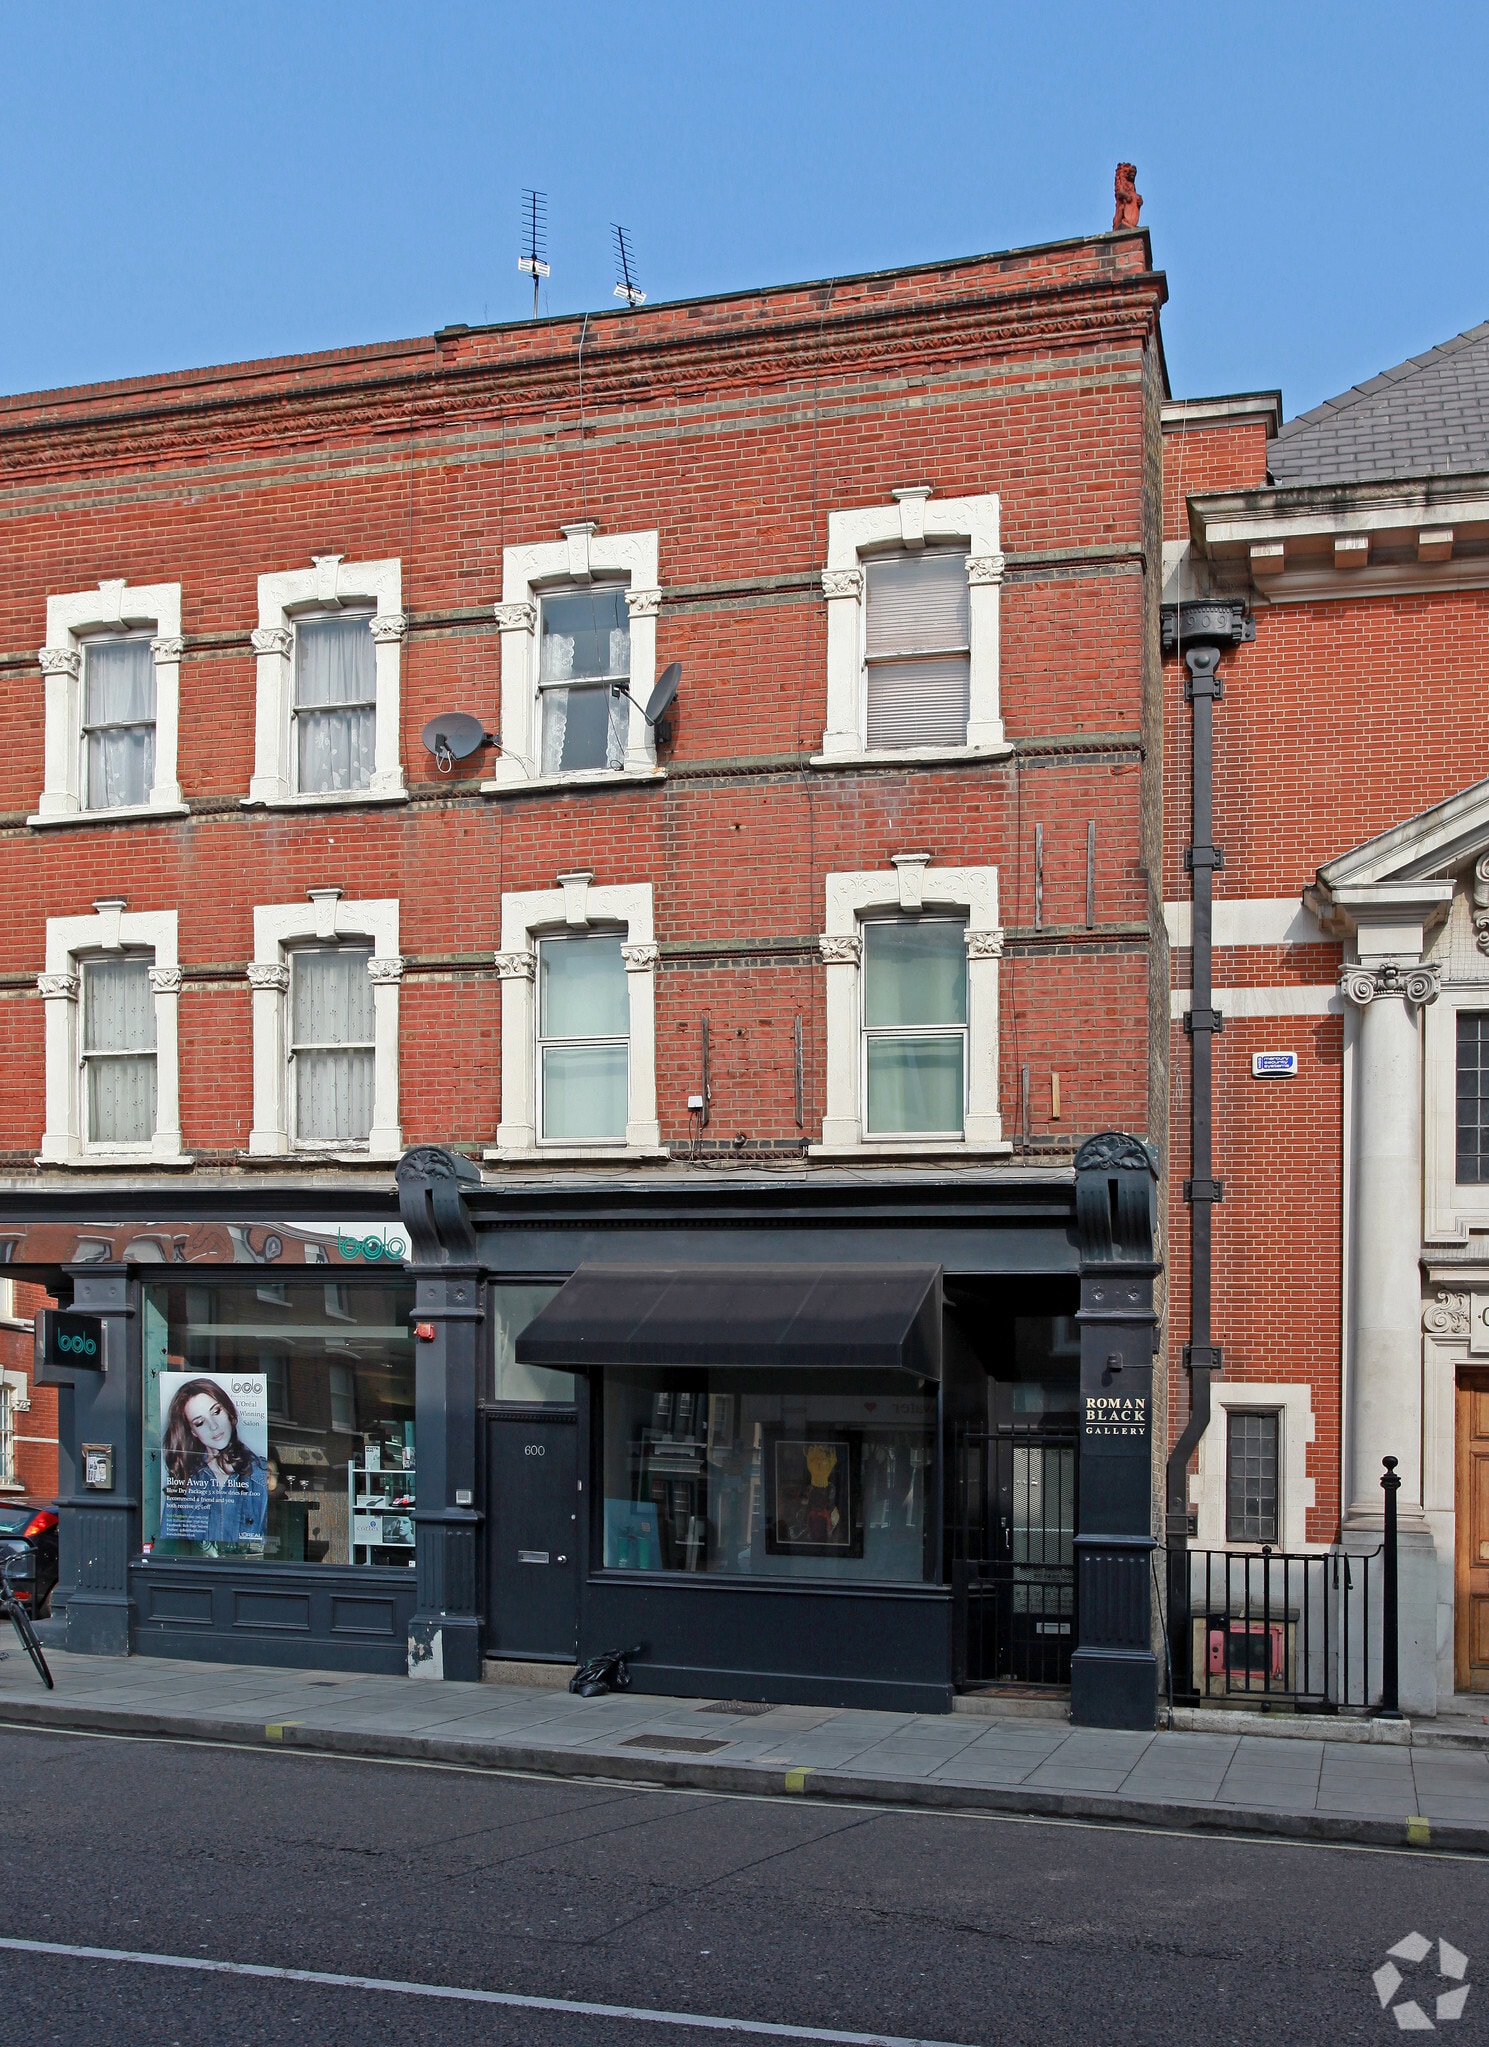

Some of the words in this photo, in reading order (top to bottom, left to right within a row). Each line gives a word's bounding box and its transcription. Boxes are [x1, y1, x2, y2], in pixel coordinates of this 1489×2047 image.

[337, 1226, 406, 1260] bob
[57, 1327, 97, 1355] bob
[231, 1378, 263, 1394] bob
[1086, 1397, 1146, 1409] ROMAN
[240, 1411, 265, 1419] Winning
[1086, 1410, 1146, 1421] BLACK
[1086, 1427, 1146, 1435] GALLERY
[524, 1444, 546, 1456] 600
[166, 1477, 185, 1486] Blow
[187, 1478, 209, 1490] Away
[227, 1479, 250, 1489] Blues
[178, 1488, 187, 1496] Dry
[188, 1489, 207, 1497] Package
